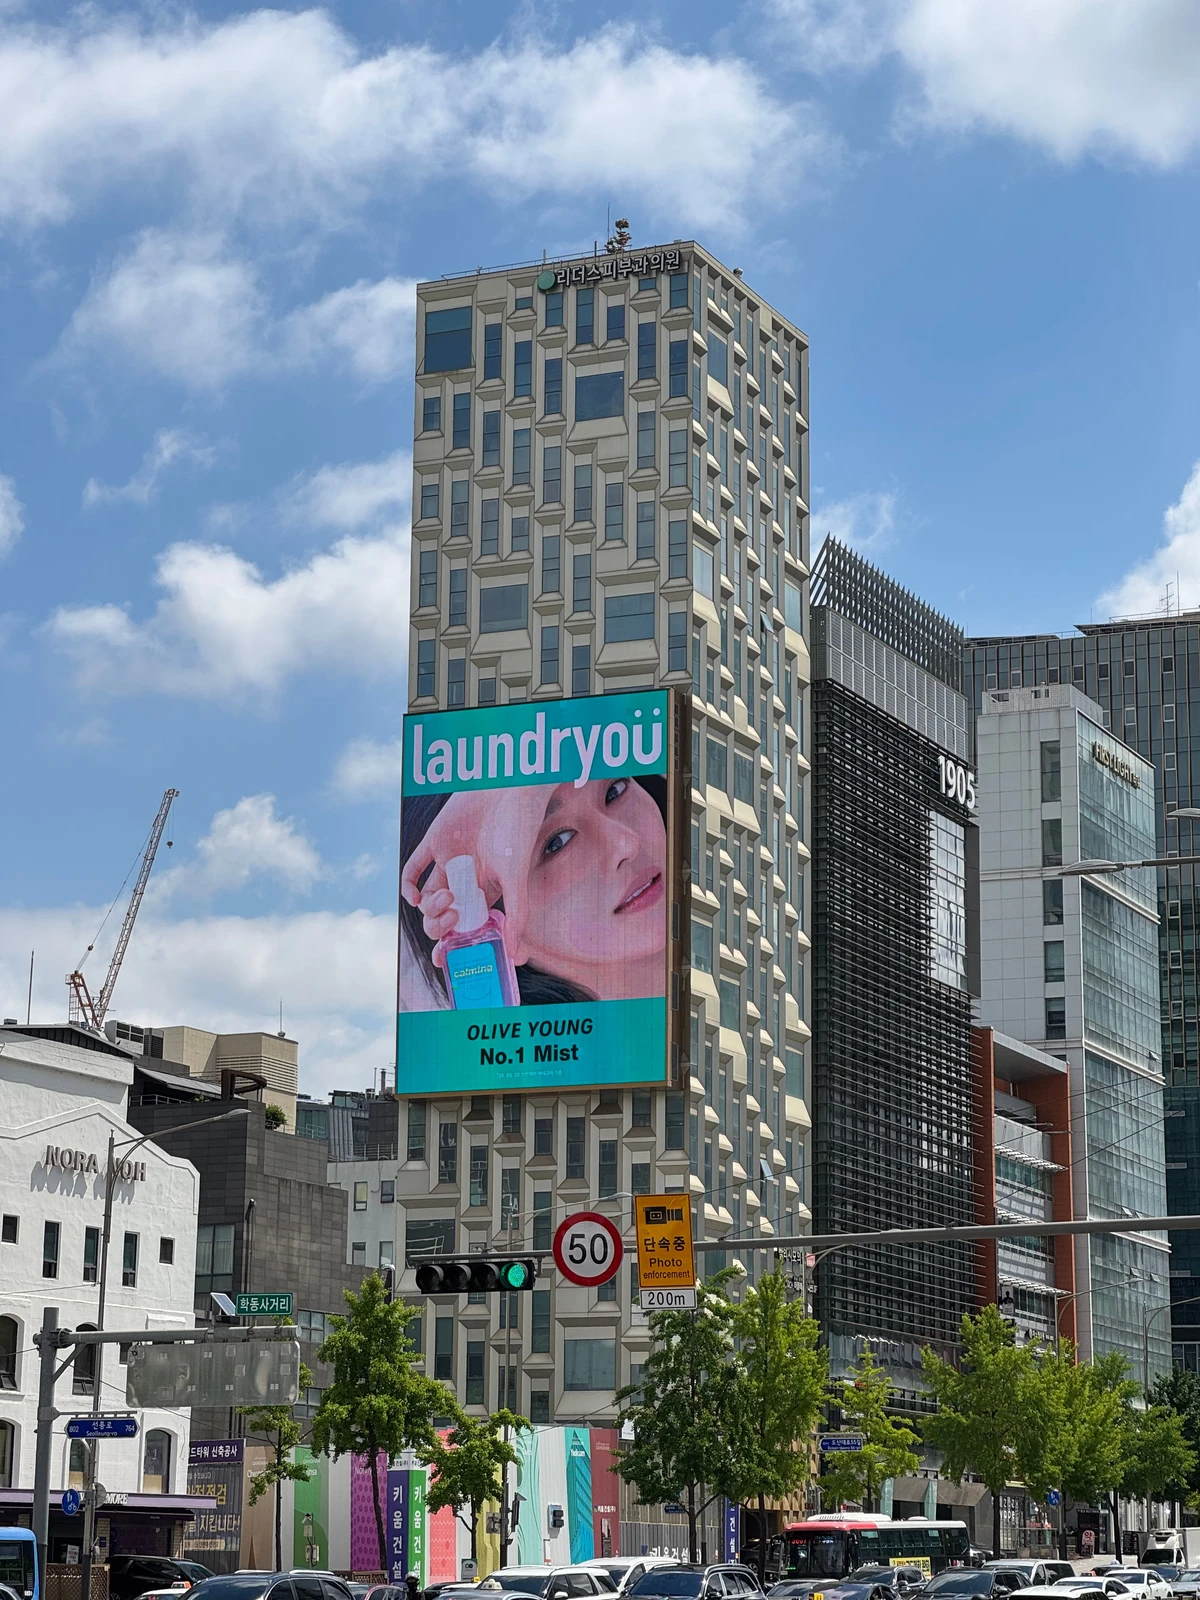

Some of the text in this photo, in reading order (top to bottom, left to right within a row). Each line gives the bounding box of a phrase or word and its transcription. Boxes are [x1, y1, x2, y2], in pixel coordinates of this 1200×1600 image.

[556, 250, 682, 287] 리더스피부과의원
[412, 708, 663, 789] laundryoü
[937, 755, 976, 810] 1905
[467, 1018, 593, 1041] OLIVE YOUNG
[480, 1044, 579, 1065] No.1 Mist
[45, 1145, 99, 1173] NORA
[568, 1233, 608, 1264] 50
[644, 1236, 685, 1252] 단속중
[649, 1257, 682, 1267] Photo
[643, 1270, 690, 1279] enforcement
[240, 1296, 289, 1312] 학동사거리
[648, 1291, 685, 1306] 200m
[212, 1444, 237, 1458] 신축공사
[392, 1485, 403, 1579] 키움건설
